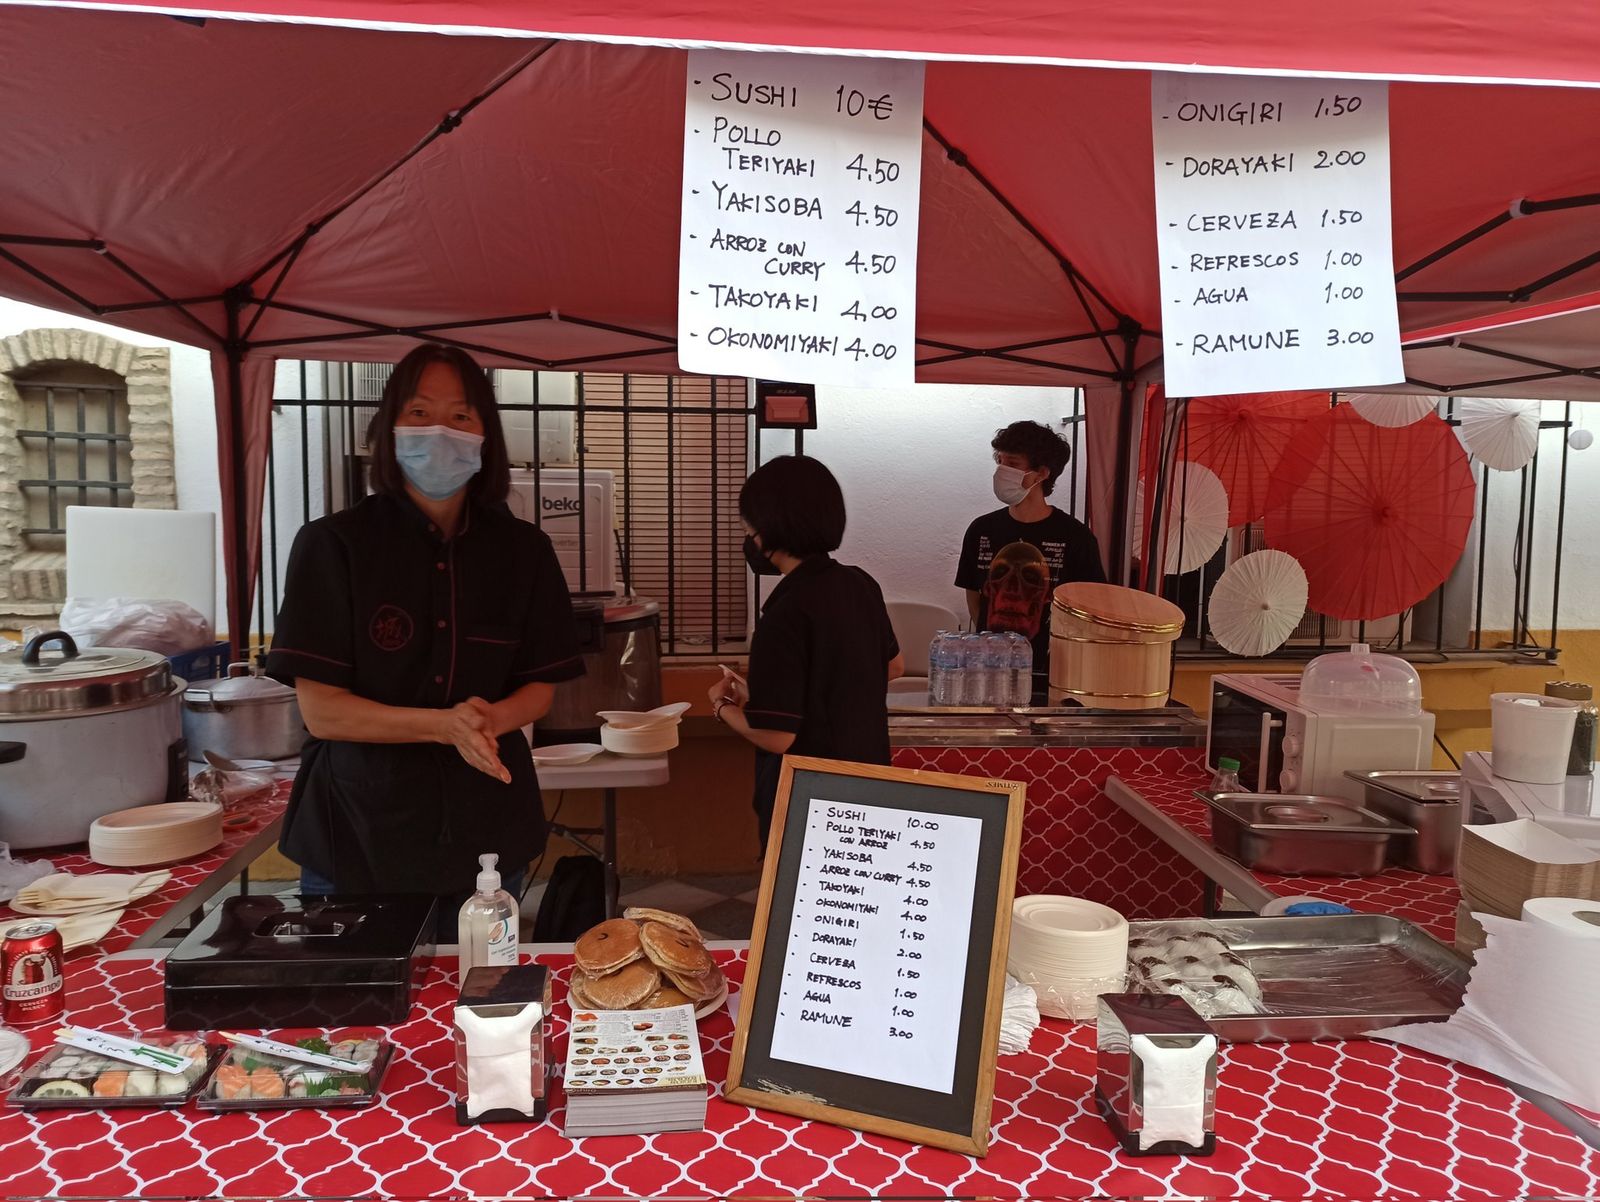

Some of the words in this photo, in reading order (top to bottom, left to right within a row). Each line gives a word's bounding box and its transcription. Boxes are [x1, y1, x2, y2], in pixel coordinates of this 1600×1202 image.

[711, 73, 796, 107] SUSHI
[836, 85, 893, 120] 10€
[1177, 102, 1282, 125] ONIGIRI
[713, 117, 781, 146] POLLO
[722, 147, 815, 177] TERIYAKI
[1183, 153, 1293, 178] DORAYAKI
[1314, 150, 1366, 169] 2.00
[712, 181, 822, 219] YAKISOBA
[846, 201, 898, 227] 4.50
[1187, 210, 1297, 232] CERVEZA
[1322, 209, 1362, 228] 1.50
[710, 228, 767, 252] ARROZ
[778, 241, 805, 257] CON
[764, 258, 825, 281] CURRY
[845, 251, 896, 274] 4.50
[1191, 252, 1299, 272] REFRESCOS
[1324, 250, 1362, 271] 1.00
[708, 284, 817, 312] TAKOYAKI
[1193, 287, 1248, 306] AGUA
[1325, 282, 1363, 303] 1.00
[708, 327, 838, 356] OKONOMIYAKI
[845, 338, 896, 361] 4.00
[1192, 329, 1300, 355] RAMUNE
[1327, 329, 1374, 346] 3.00
[826, 822, 854, 835] POLLO
[858, 826, 901, 841] TERIYAKI
[827, 807, 866, 822] SUSHI
[907, 817, 939, 831] 10.00
[858, 838, 888, 850] ARROZ
[823, 847, 873, 864] YAKISOBA
[907, 862, 933, 872] 4.50
[820, 865, 850, 877] ARROZ
[854, 869, 872, 879] CON
[873, 871, 902, 885] CURRY
[906, 878, 930, 888] 4.50
[816, 898, 879, 915] OKONOMIYAKI
[819, 880, 864, 895] TAKOYAKI
[903, 896, 928, 907] 4.00
[814, 915, 859, 929] ONIGIRI
[900, 928, 925, 941] 1.50
[812, 932, 856, 947] DORAYAKI
[897, 949, 922, 959] 2.00
[806, 972, 862, 990] REFRESCOS
[894, 988, 917, 999] 1.00
[897, 968, 920, 979] 1.50
[803, 990, 831, 1004] AGUA
[892, 1006, 914, 1018] 1.00
[800, 1010, 852, 1027] RAMUNE
